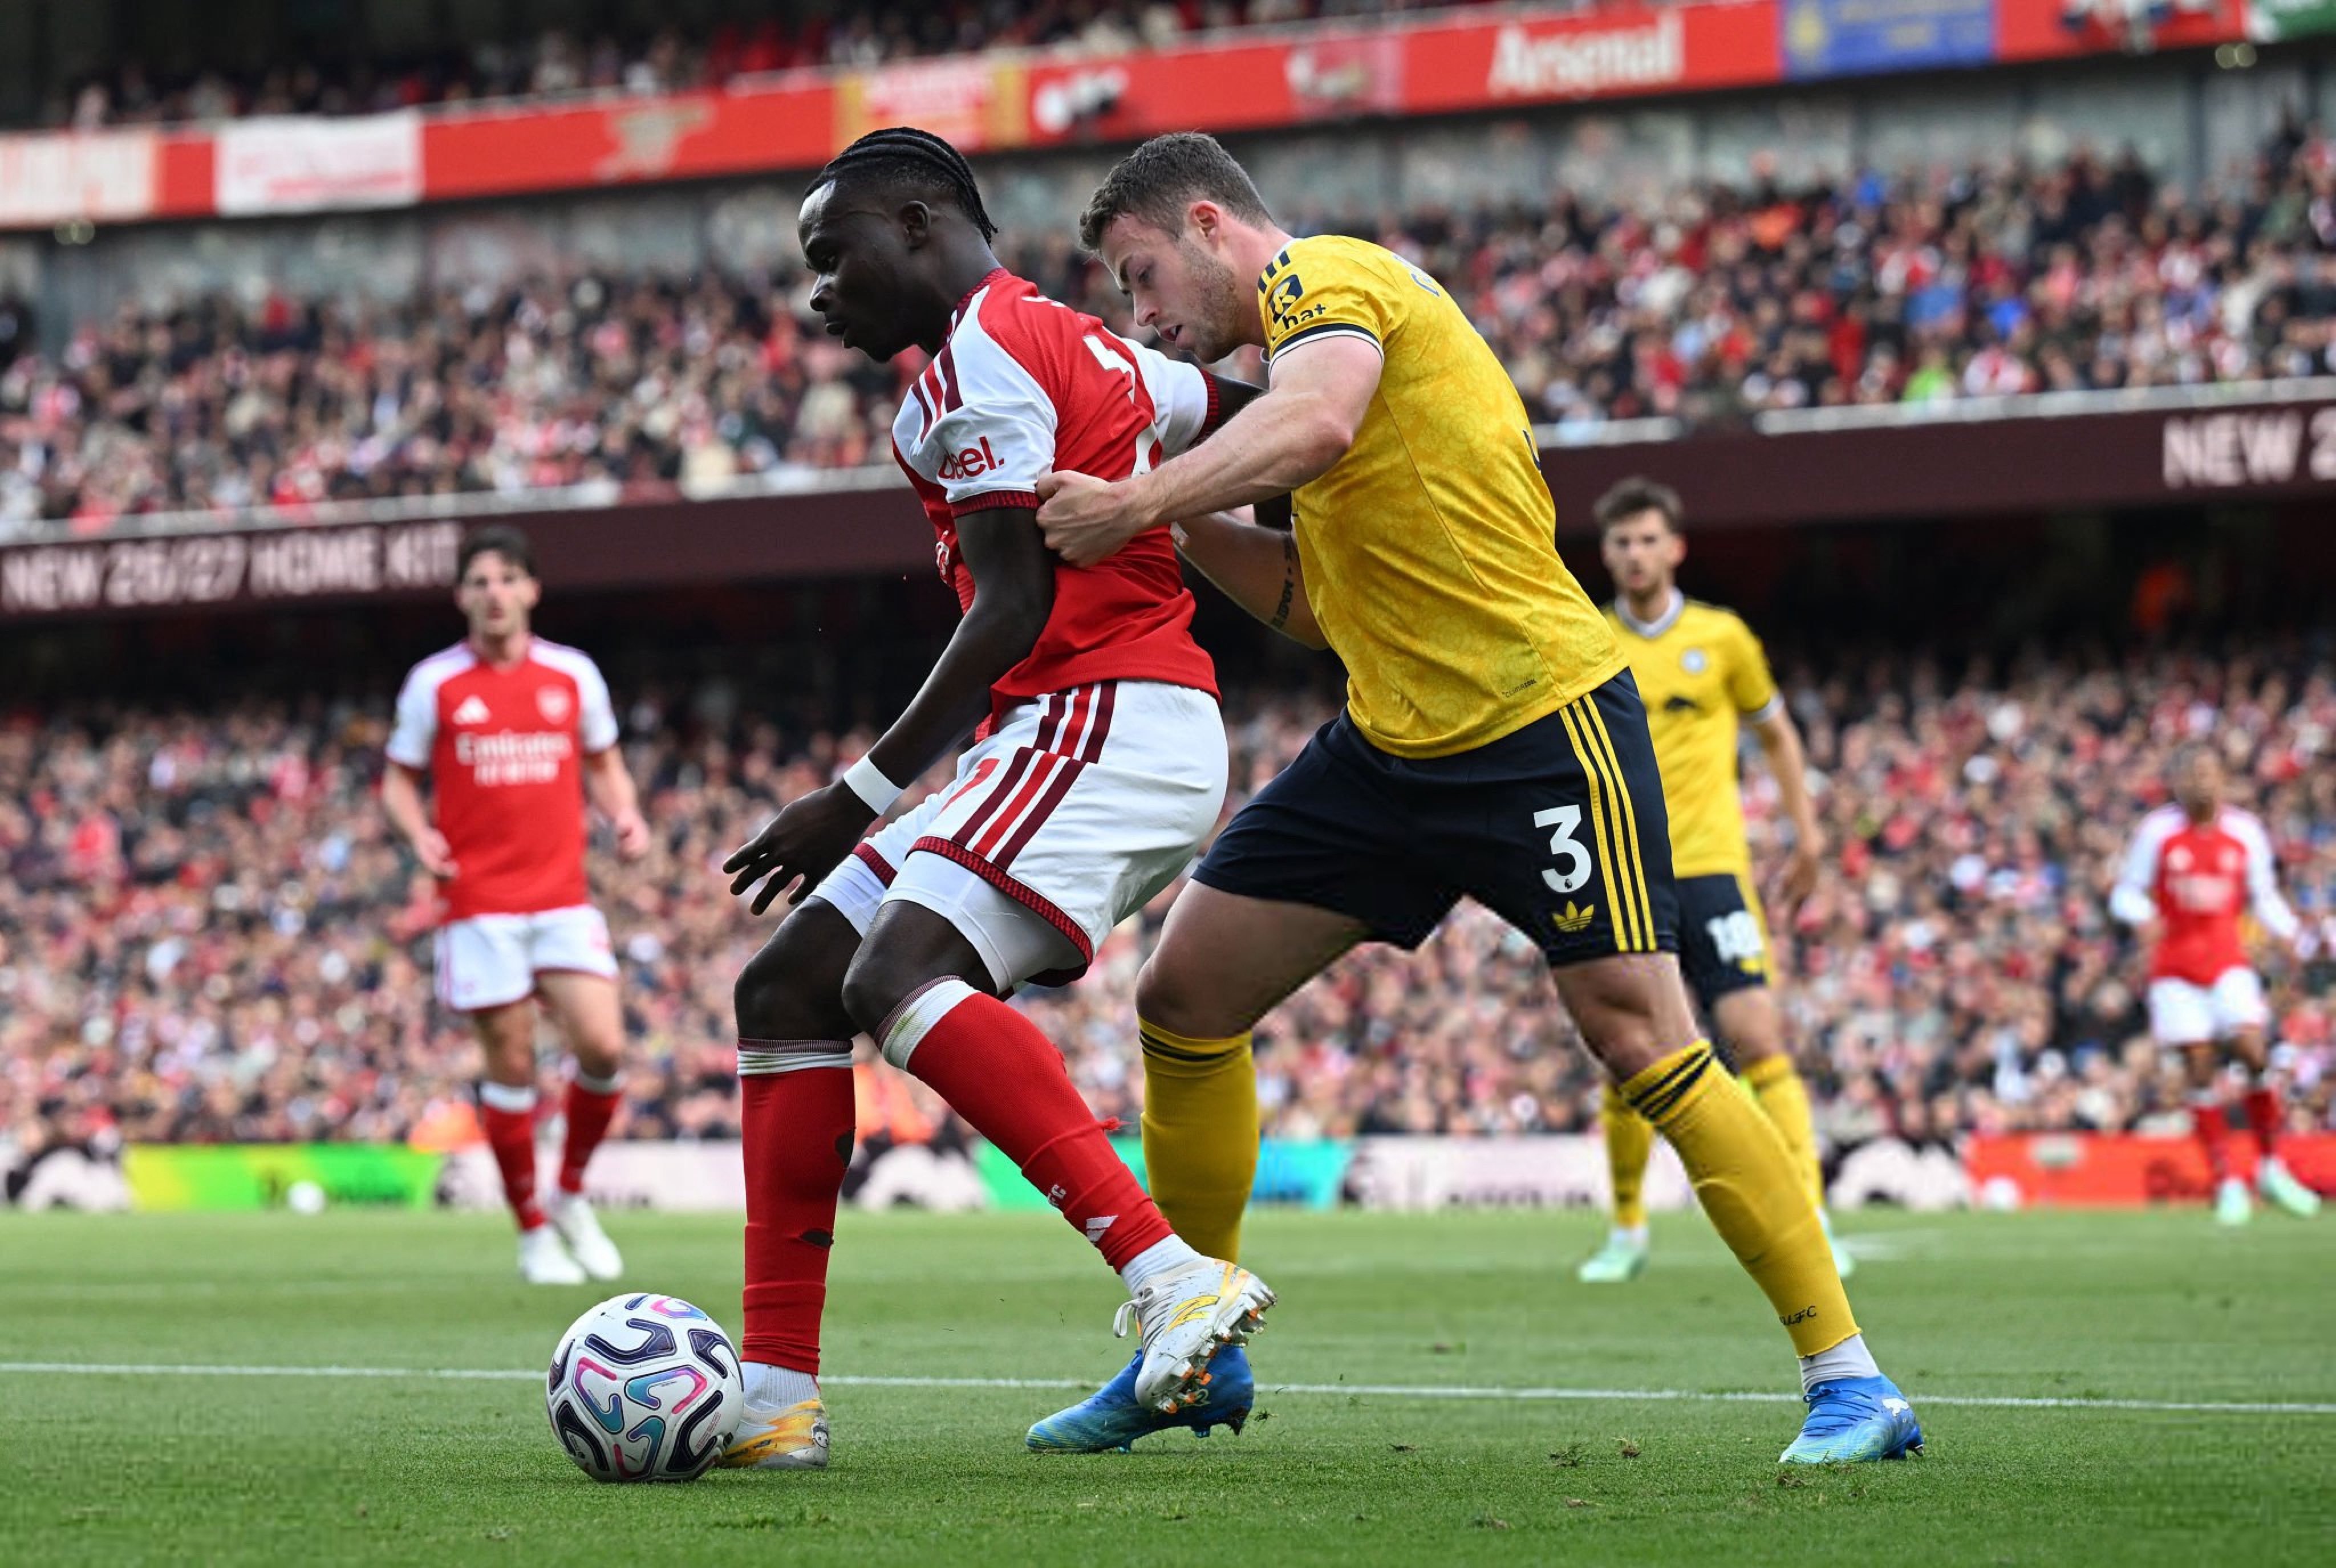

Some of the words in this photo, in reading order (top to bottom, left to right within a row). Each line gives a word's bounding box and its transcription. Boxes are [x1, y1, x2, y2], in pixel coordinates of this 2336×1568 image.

[2163, 408, 2304, 489] NEW
[2, 547, 102, 611] NEW
[249, 528, 383, 598] HOME
[387, 519, 461, 588] KIT
[1534, 804, 1592, 893] 3
